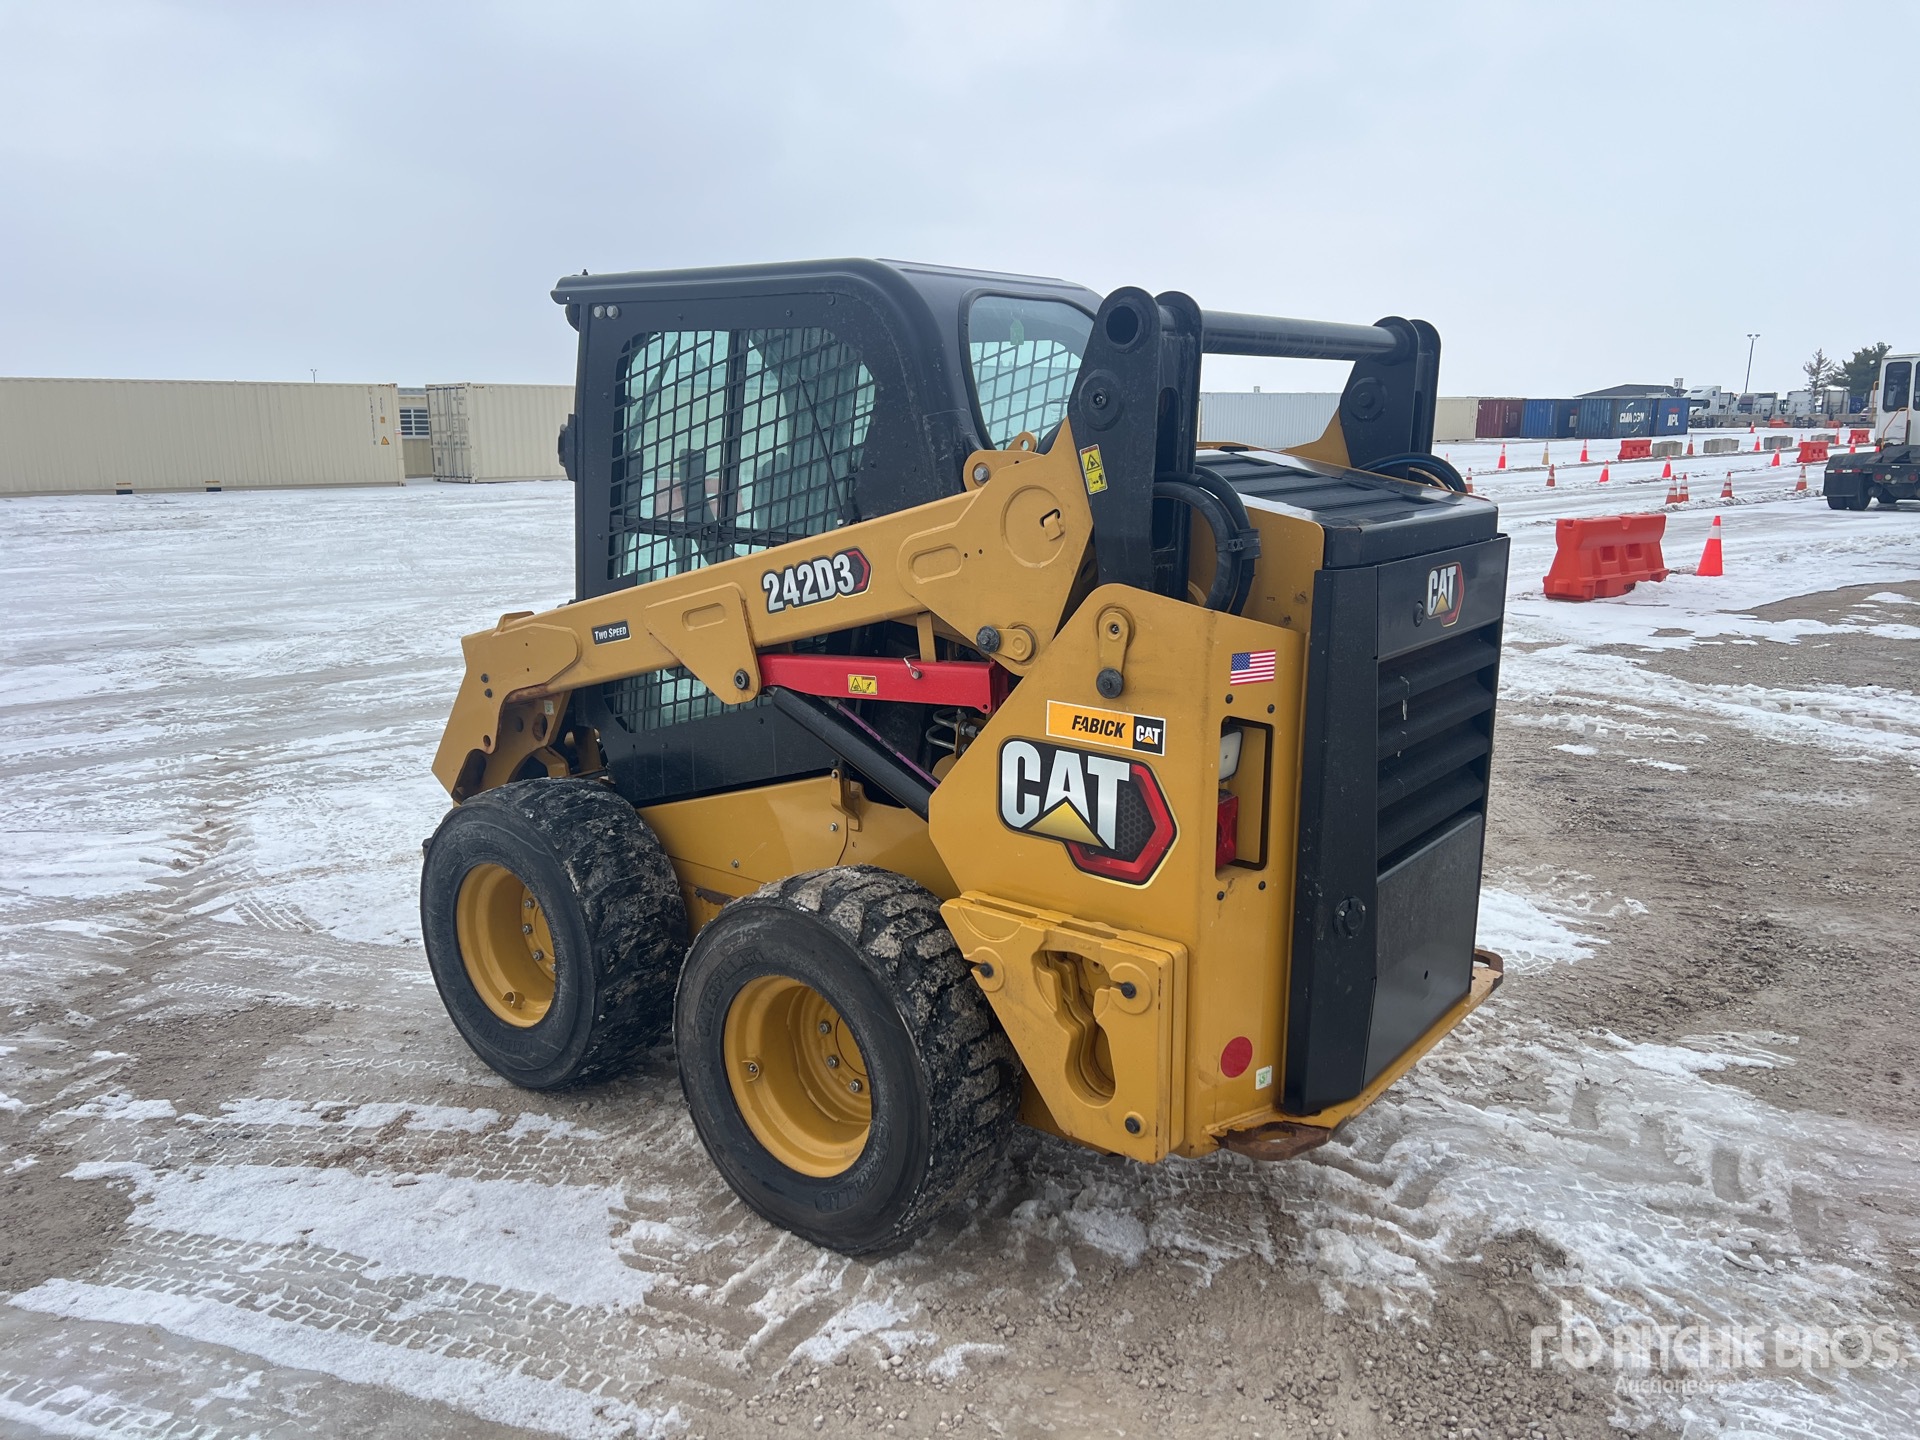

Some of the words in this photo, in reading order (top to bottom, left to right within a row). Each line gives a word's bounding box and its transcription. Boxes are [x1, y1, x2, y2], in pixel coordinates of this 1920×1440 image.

[763, 554, 855, 611] 242D3
[1427, 565, 1457, 616] CAT
[1071, 715, 1126, 738] FABICK
[1136, 725, 1161, 745] CAT
[1002, 740, 1130, 850] CAT
